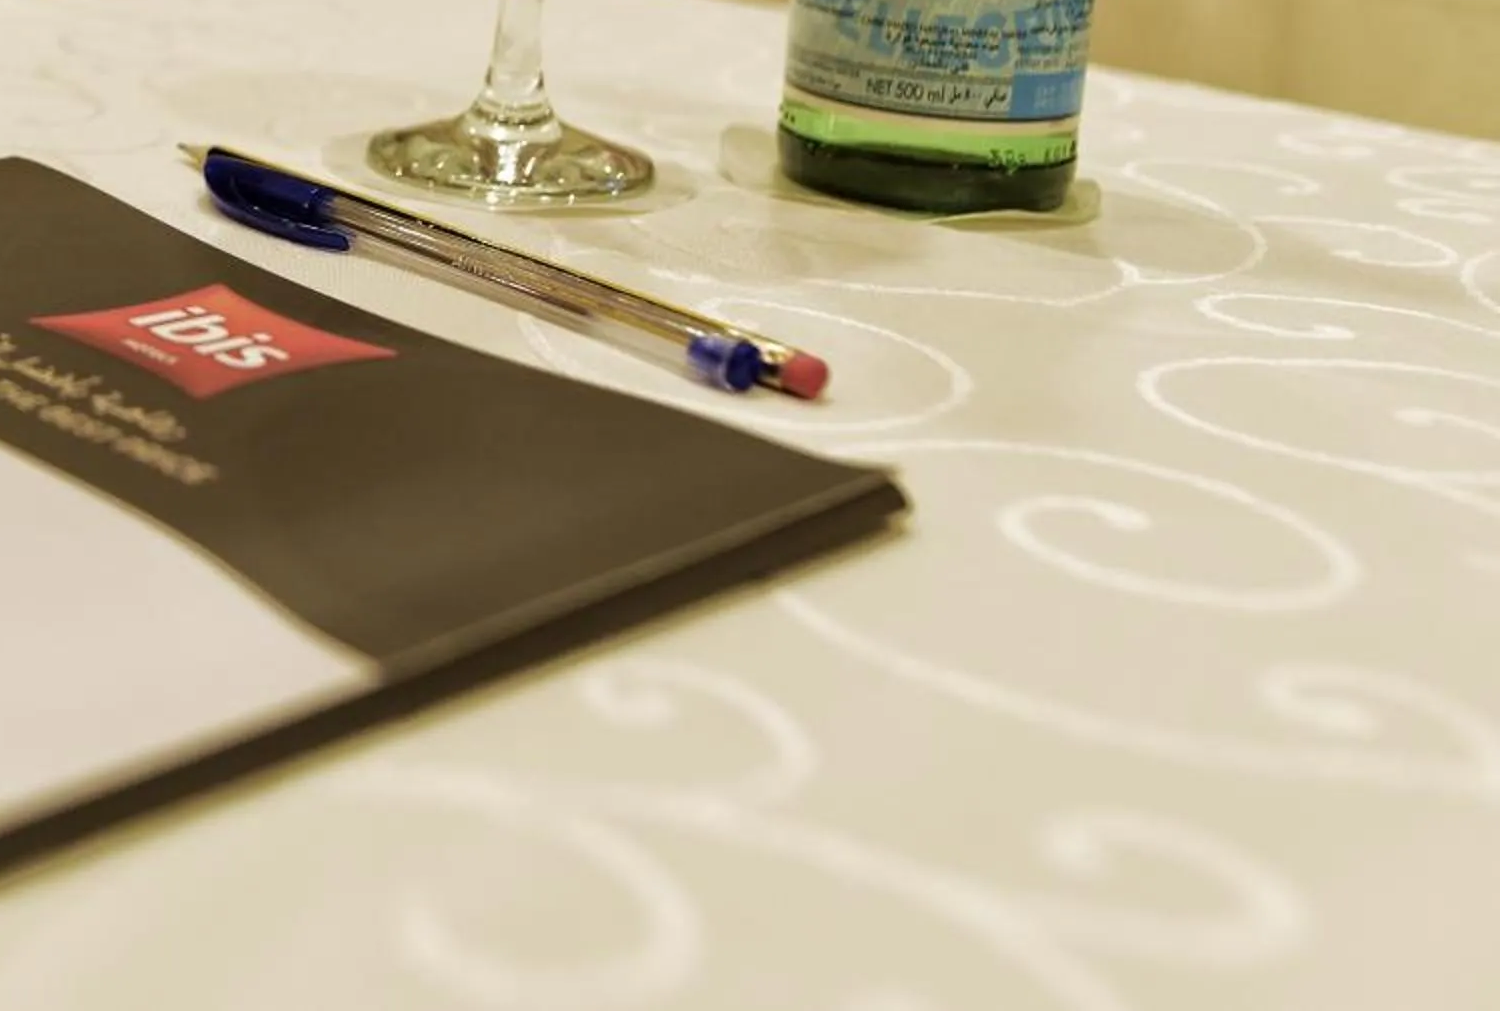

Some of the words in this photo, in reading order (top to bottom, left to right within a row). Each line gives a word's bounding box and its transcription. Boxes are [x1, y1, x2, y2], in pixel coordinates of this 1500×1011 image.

[866, 77, 894, 96] NET
[896, 79, 925, 103] 500
[927, 84, 946, 104] ml
[128, 304, 291, 370] ibis
